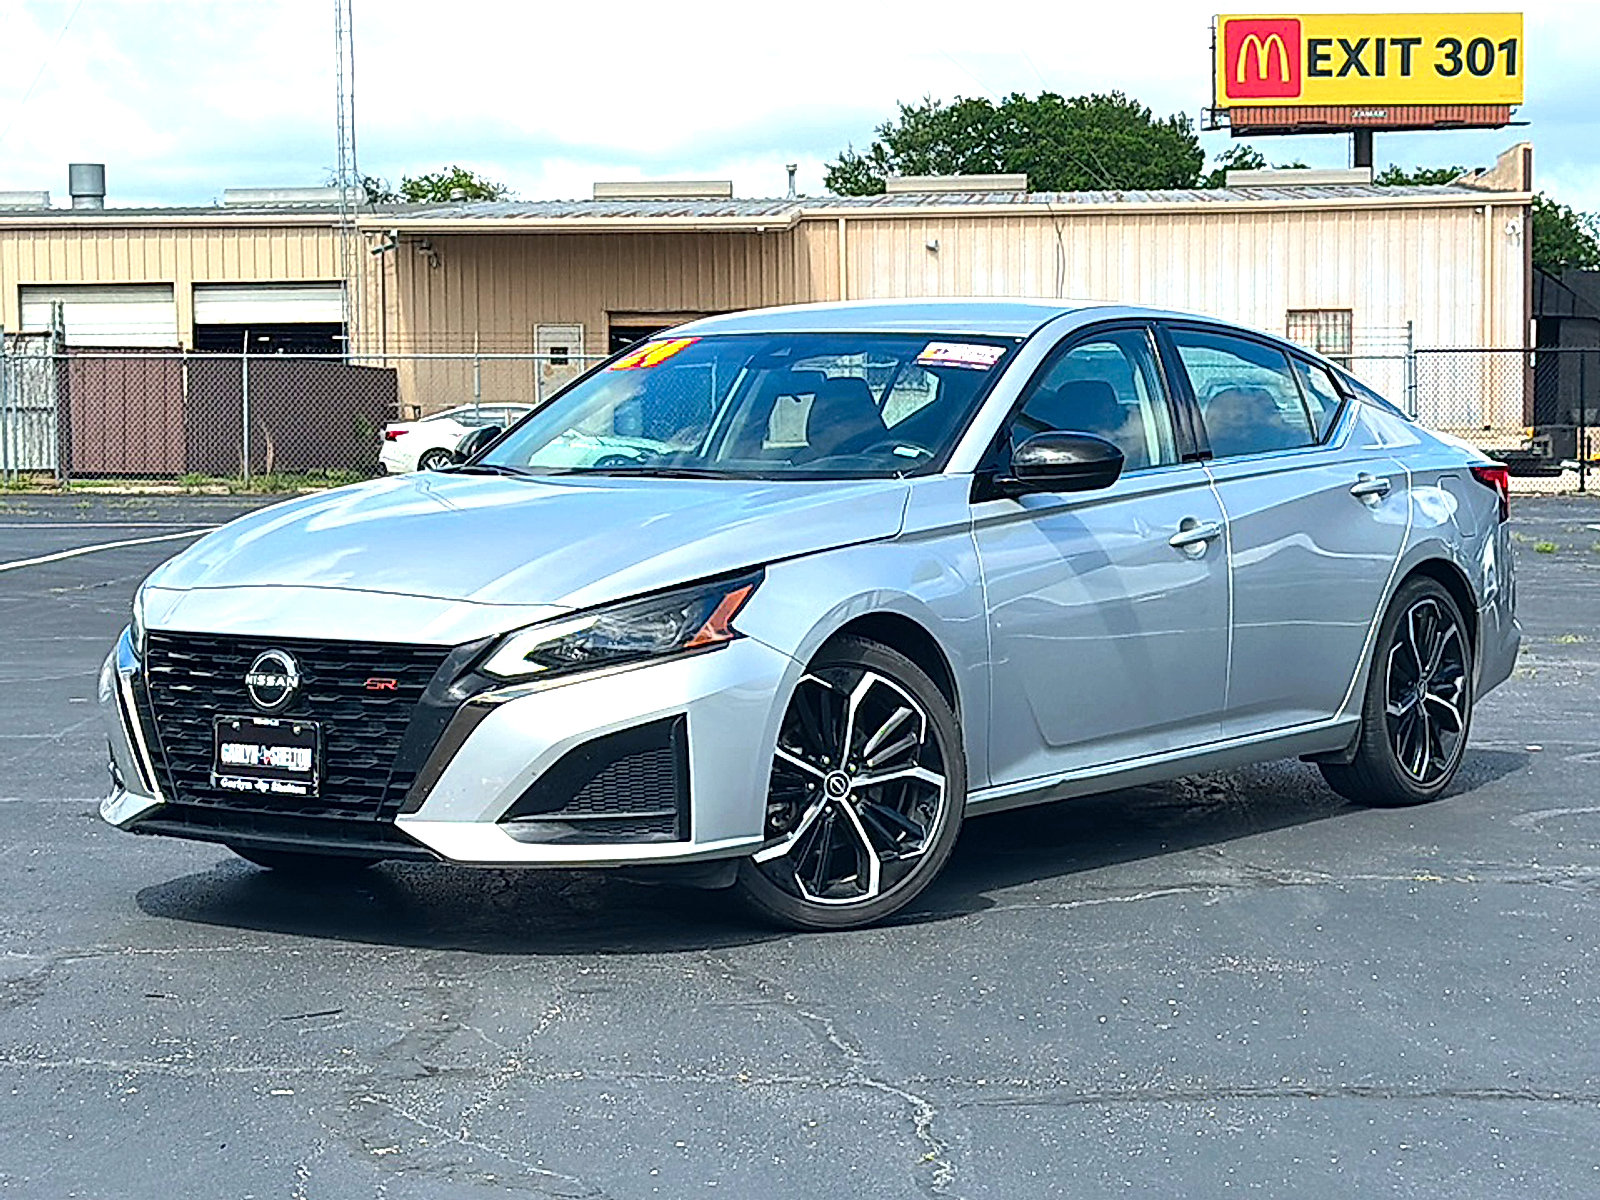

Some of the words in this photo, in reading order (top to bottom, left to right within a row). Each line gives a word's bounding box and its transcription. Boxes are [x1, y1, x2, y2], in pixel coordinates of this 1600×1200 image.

[1307, 37, 1422, 78] EXIT
[1434, 37, 1518, 77] 301
[245, 673, 299, 688] NISSAN
[365, 677, 398, 690] SR
